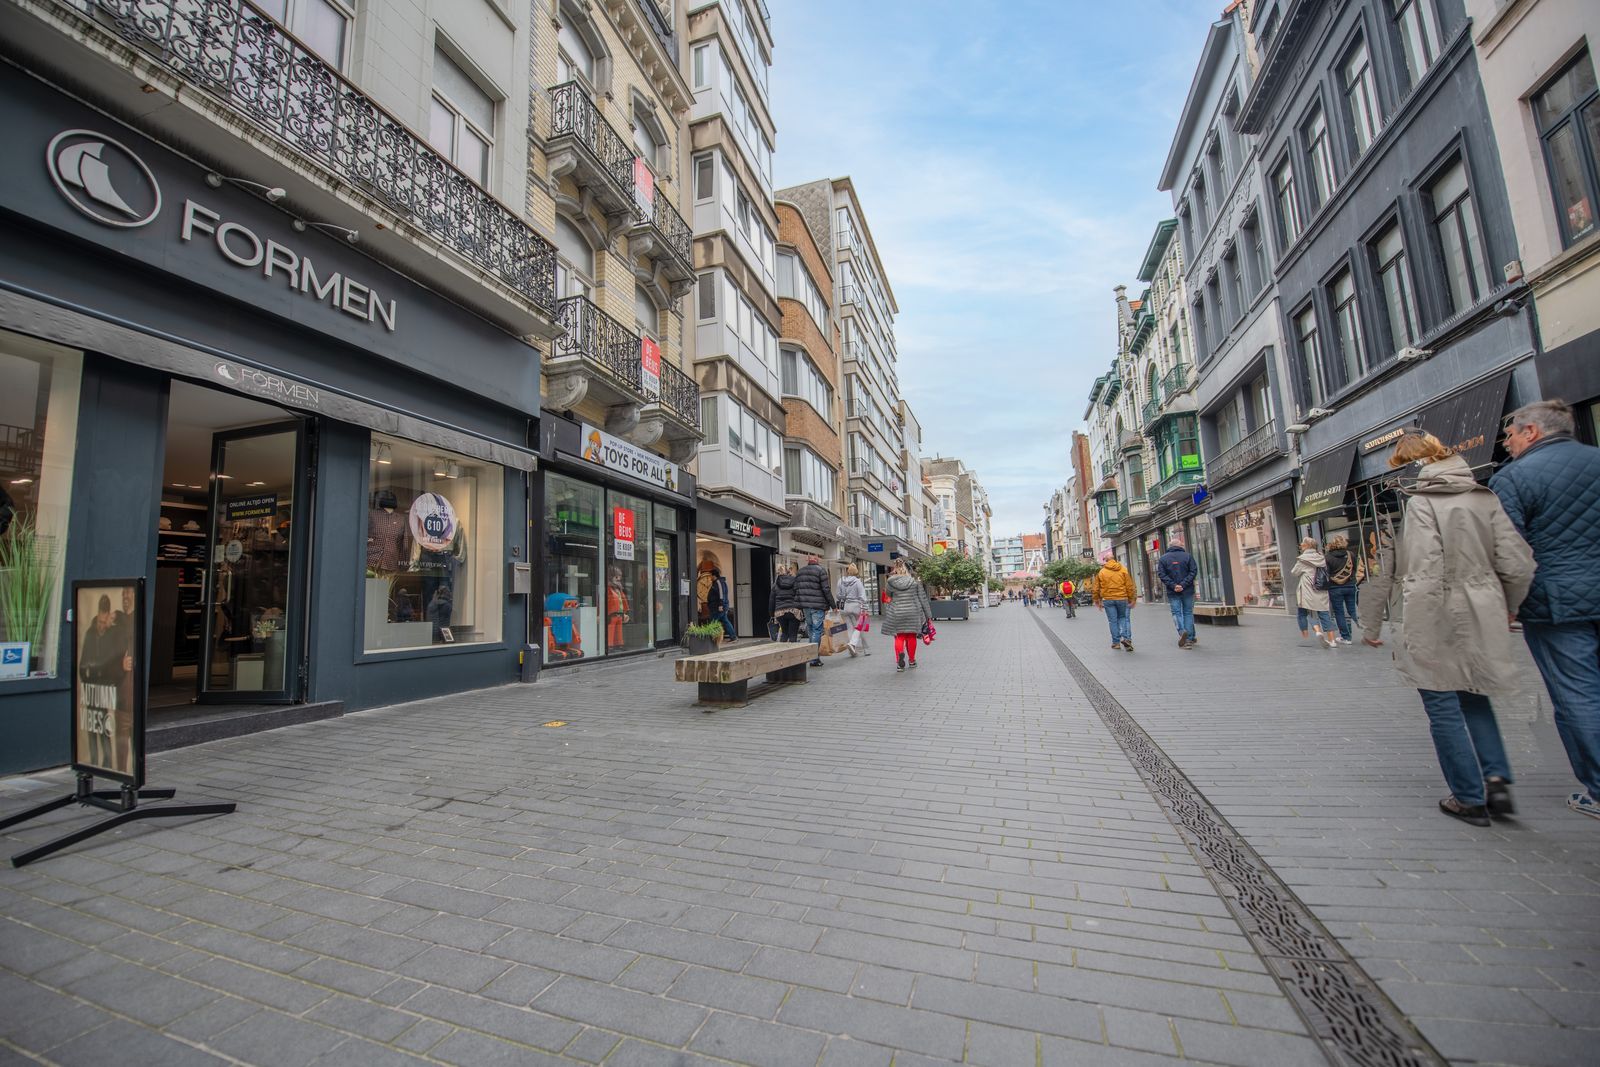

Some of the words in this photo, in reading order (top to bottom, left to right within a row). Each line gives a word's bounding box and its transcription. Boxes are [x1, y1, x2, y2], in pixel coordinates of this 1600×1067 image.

[182, 199, 397, 331] FORMEN
[241, 368, 319, 403] FORMEN
[604, 446, 629, 469] TOYS
[631, 457, 649, 476] FOR
[650, 465, 664, 483] ALL
[618, 512, 626, 525] DE
[618, 525, 632, 538] BEUS
[80, 682, 117, 710] AUTUMN
[80, 707, 103, 734] VIBES
